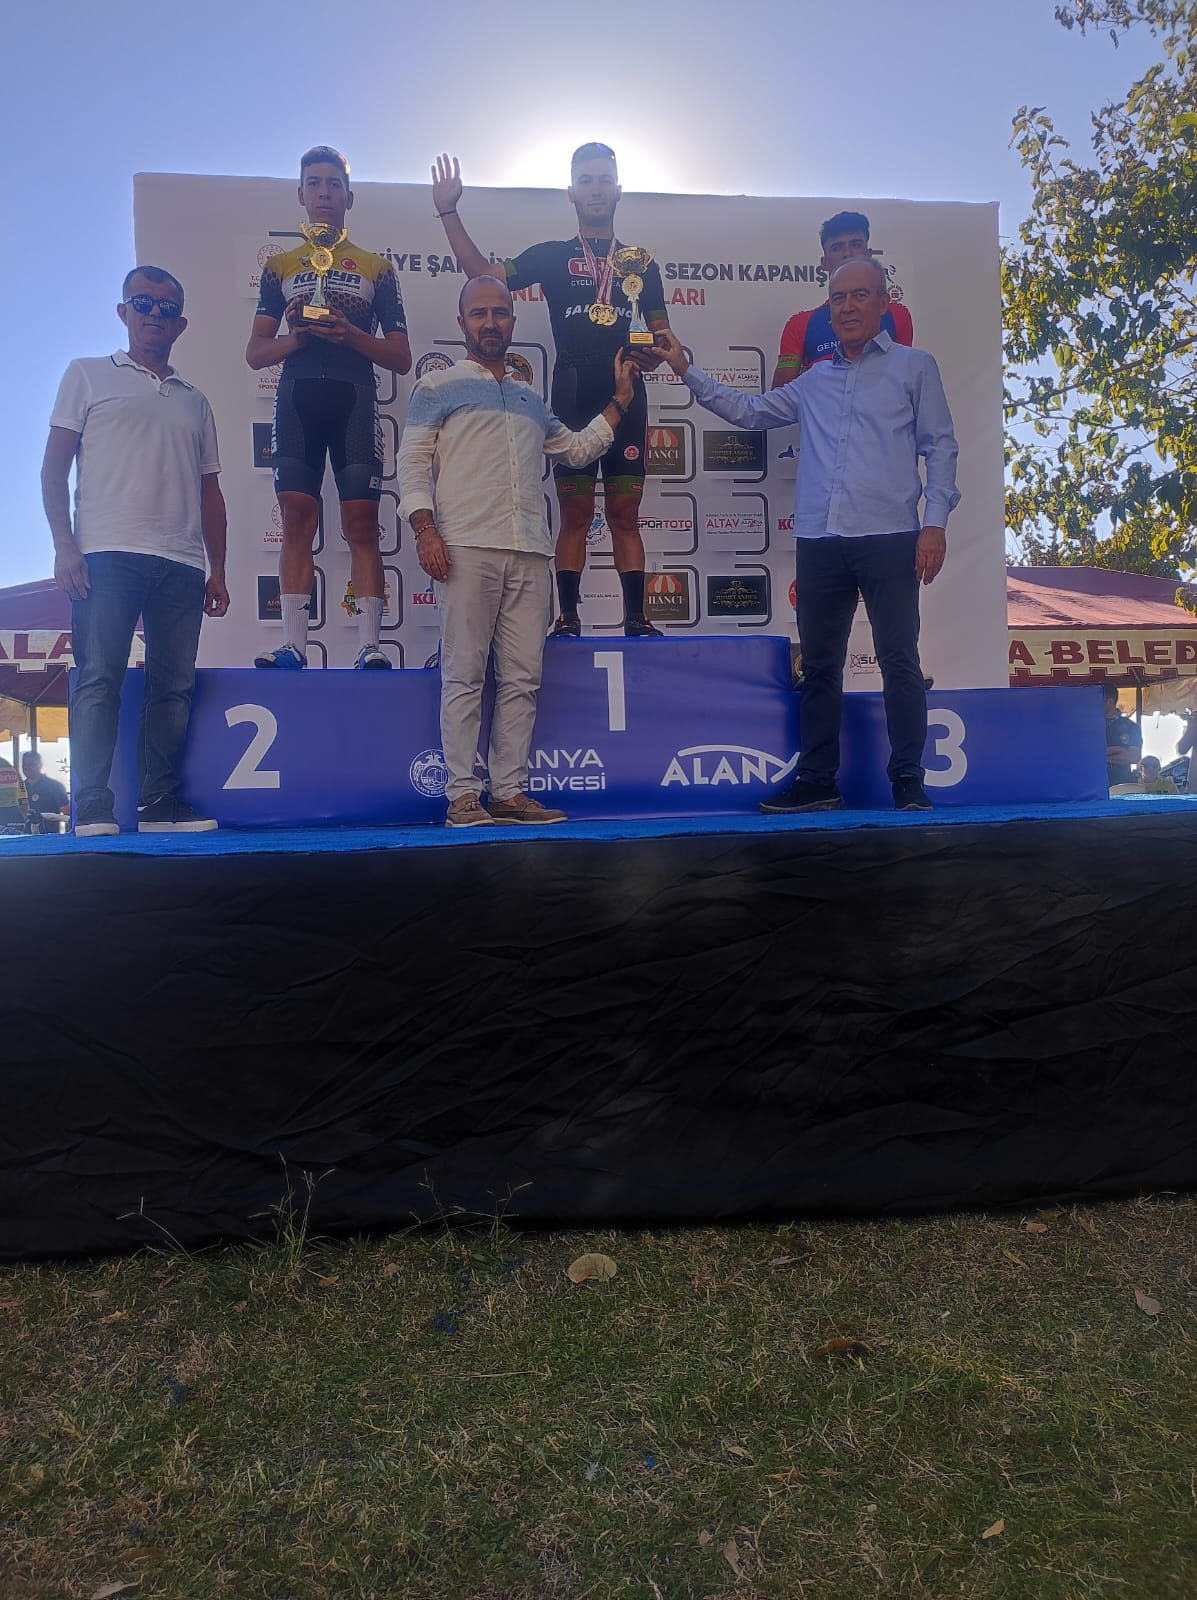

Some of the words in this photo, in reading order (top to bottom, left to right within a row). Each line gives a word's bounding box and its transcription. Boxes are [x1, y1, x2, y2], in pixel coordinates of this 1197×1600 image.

[372, 248, 422, 272] İYE
[665, 262, 734, 281] SEZON
[738, 264, 831, 288] KAPANIŞ
[570, 279, 595, 288] CYCLI
[663, 287, 705, 306] LARI
[564, 303, 632, 319] SALNO
[816, 340, 841, 353] GEN
[706, 518, 740, 529] ALTAV
[860, 656, 877, 665] SU
[1050, 639, 1197, 665] BELED
[593, 651, 626, 732] 1
[223, 703, 281, 790] 2
[924, 708, 967, 787] 3
[474, 748, 605, 770] ANYA
[660, 744, 801, 787] ALANY
